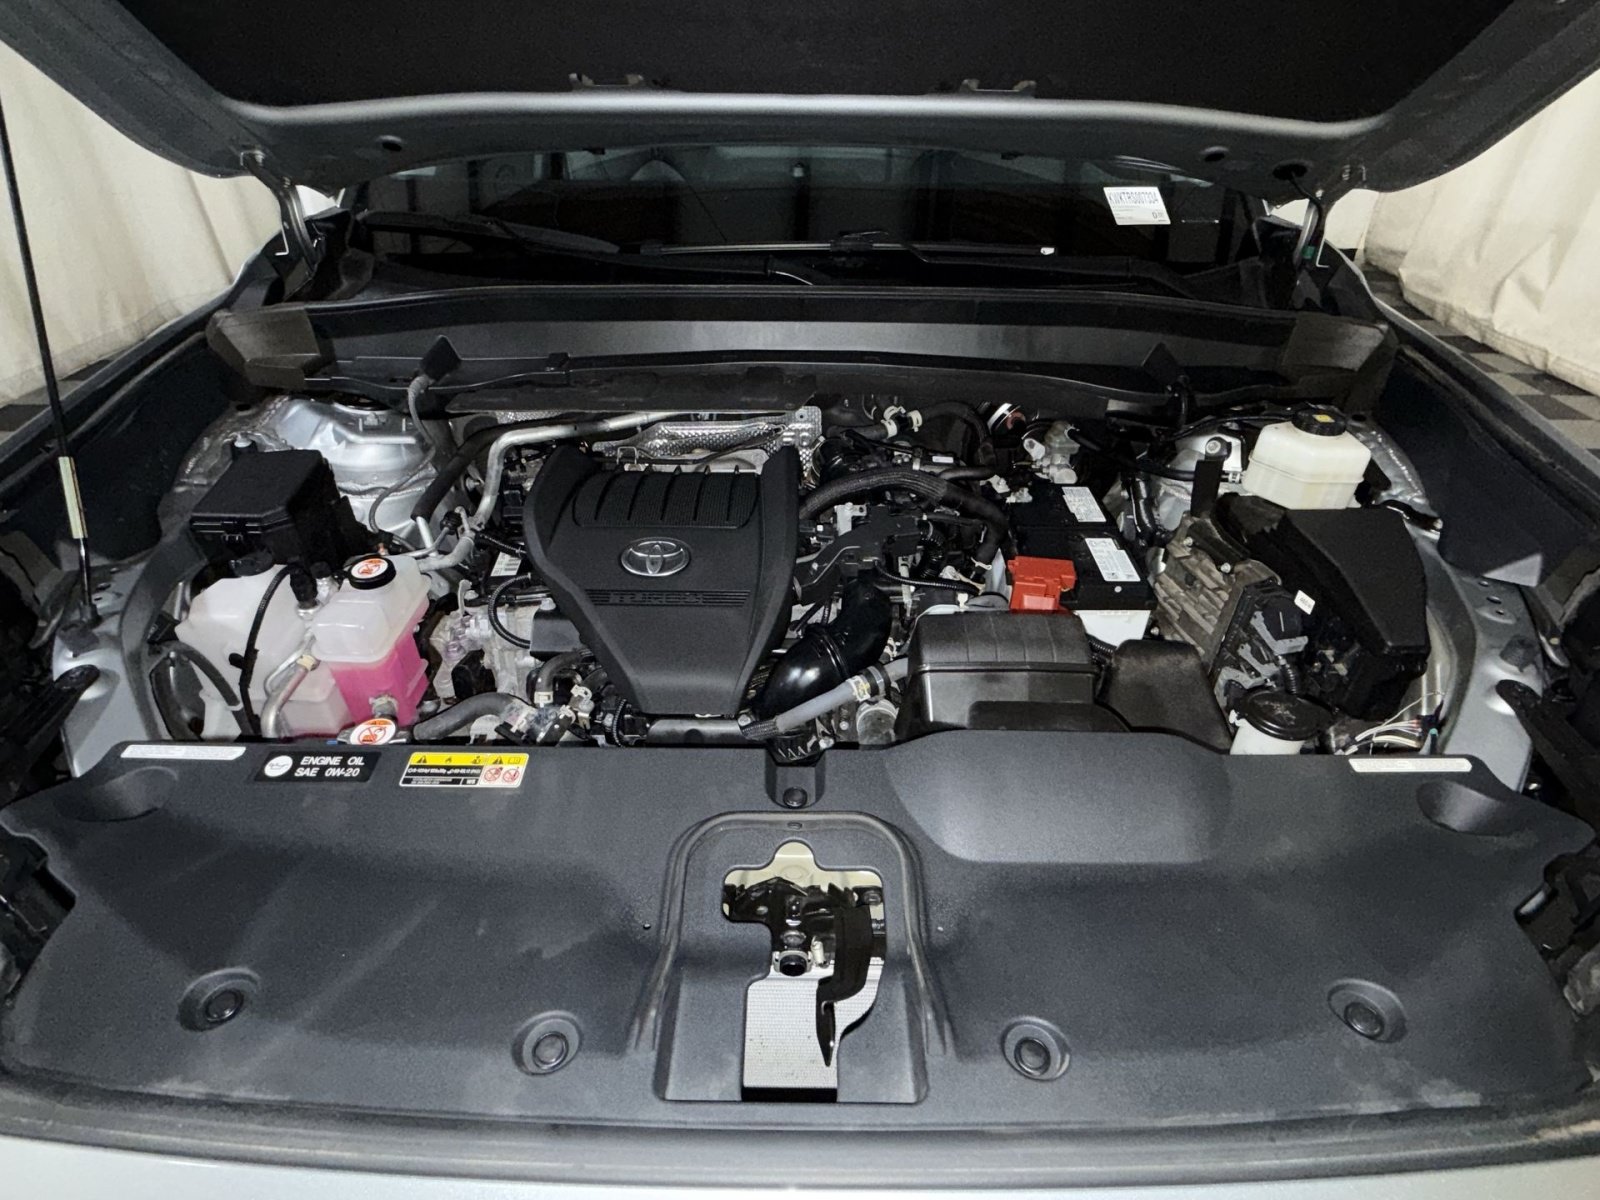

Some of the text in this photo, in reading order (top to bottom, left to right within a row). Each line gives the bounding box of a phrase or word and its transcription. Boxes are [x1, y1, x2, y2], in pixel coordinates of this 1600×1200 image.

[299, 756, 365, 766] ENGINE OIL
[294, 767, 361, 777] SAE 0W-20
